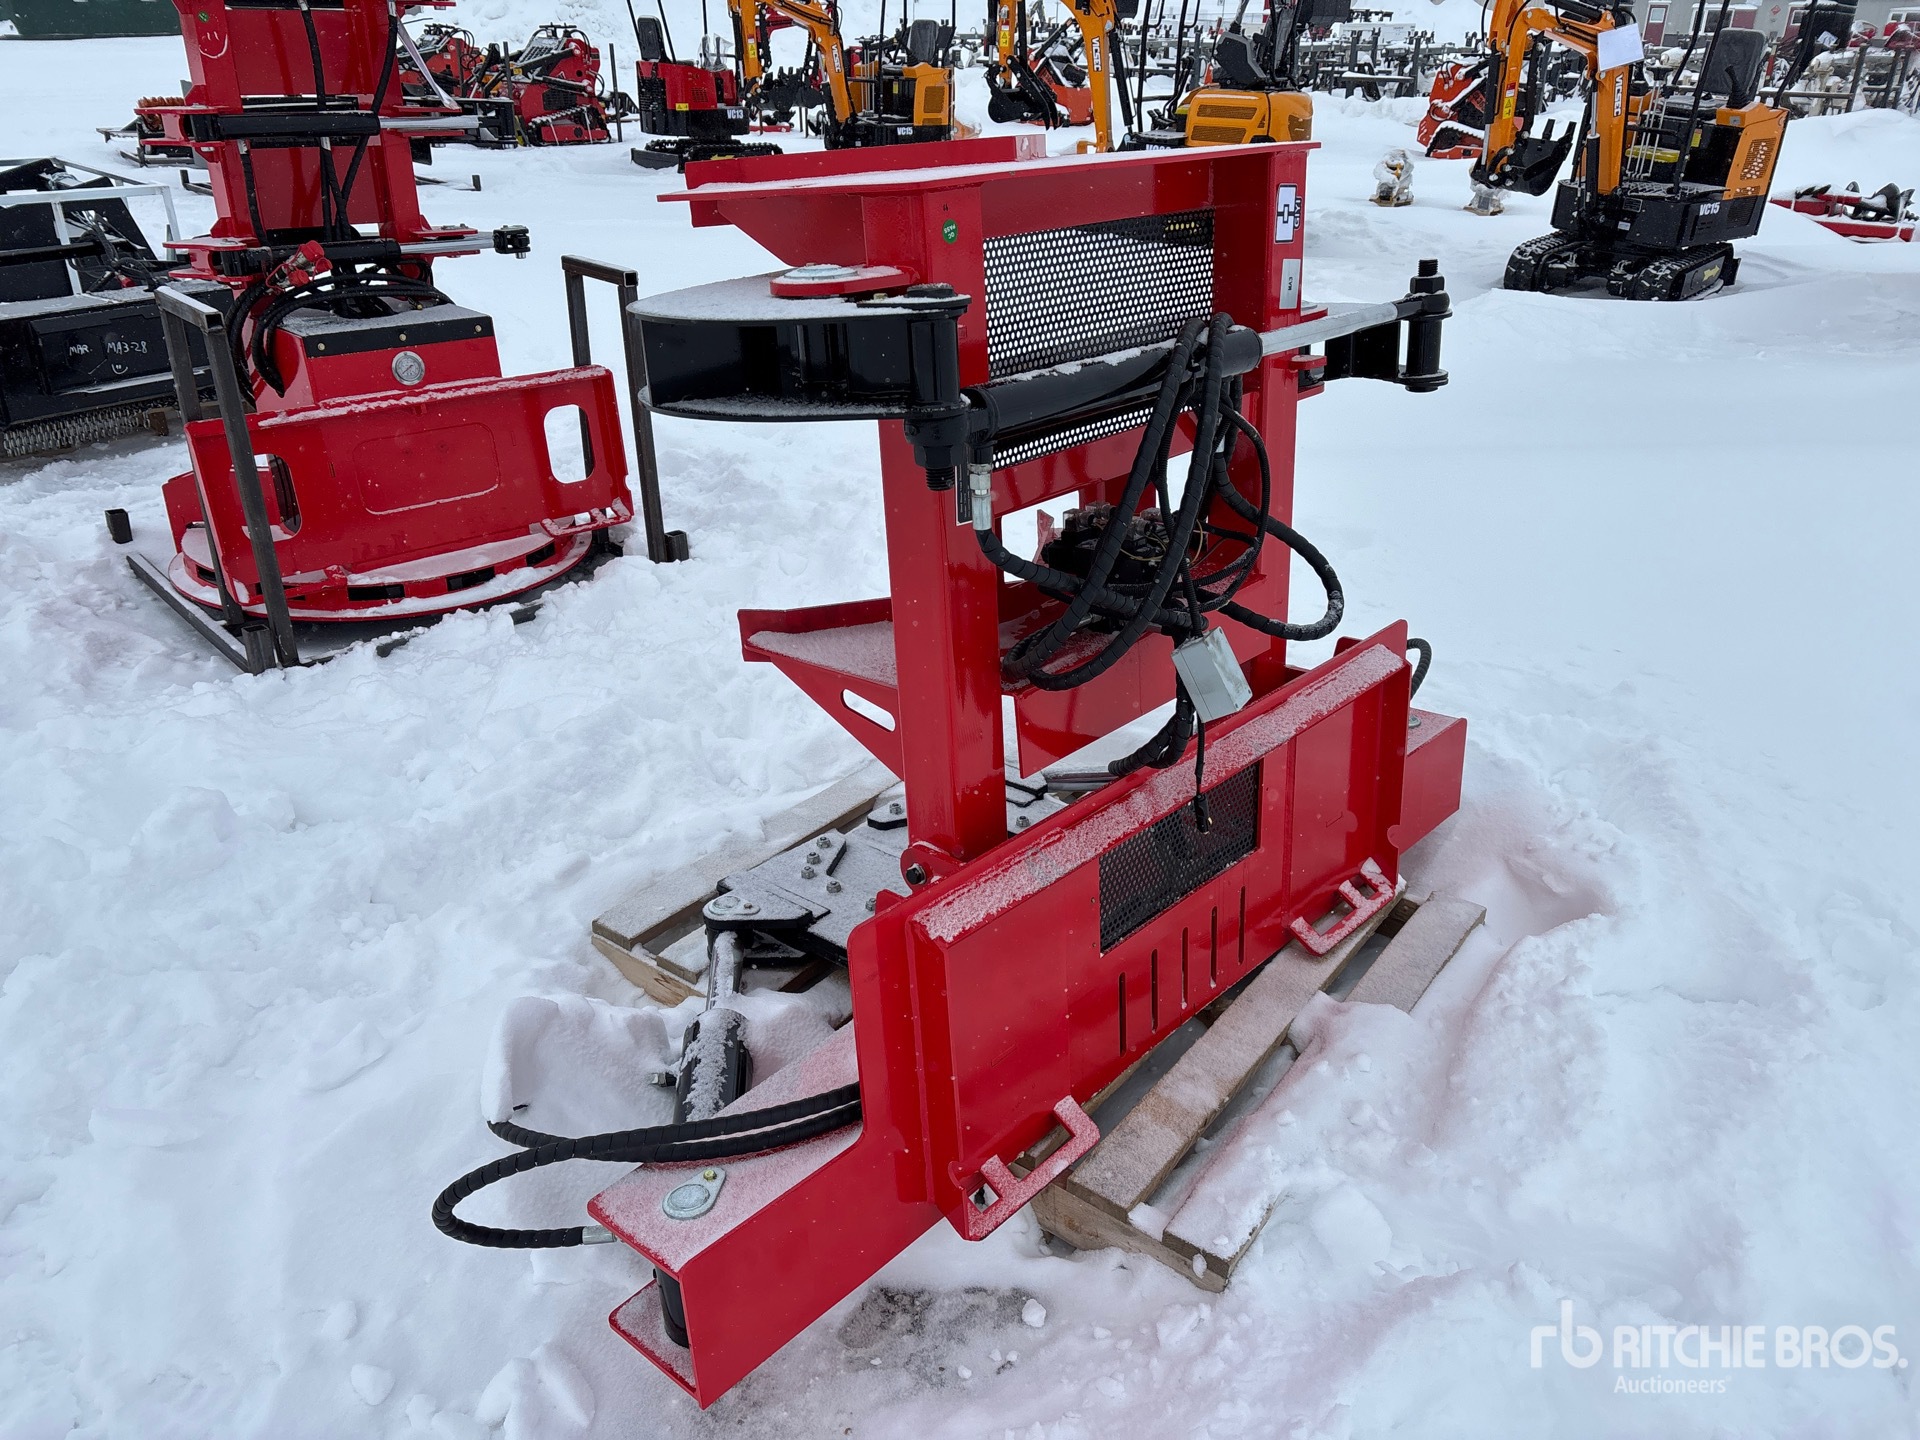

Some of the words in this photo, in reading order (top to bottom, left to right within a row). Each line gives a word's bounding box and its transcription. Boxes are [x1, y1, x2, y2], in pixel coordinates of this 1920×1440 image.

[1092, 37, 1102, 71] VICSEC
[1614, 73, 1624, 117] VICSEC
[727, 109, 744, 119] VC13
[897, 126, 913, 136] VC15
[1294, 198, 1302, 228] GIYI
[1700, 202, 1720, 216] VC15
[944, 224, 956, 234] PASS
